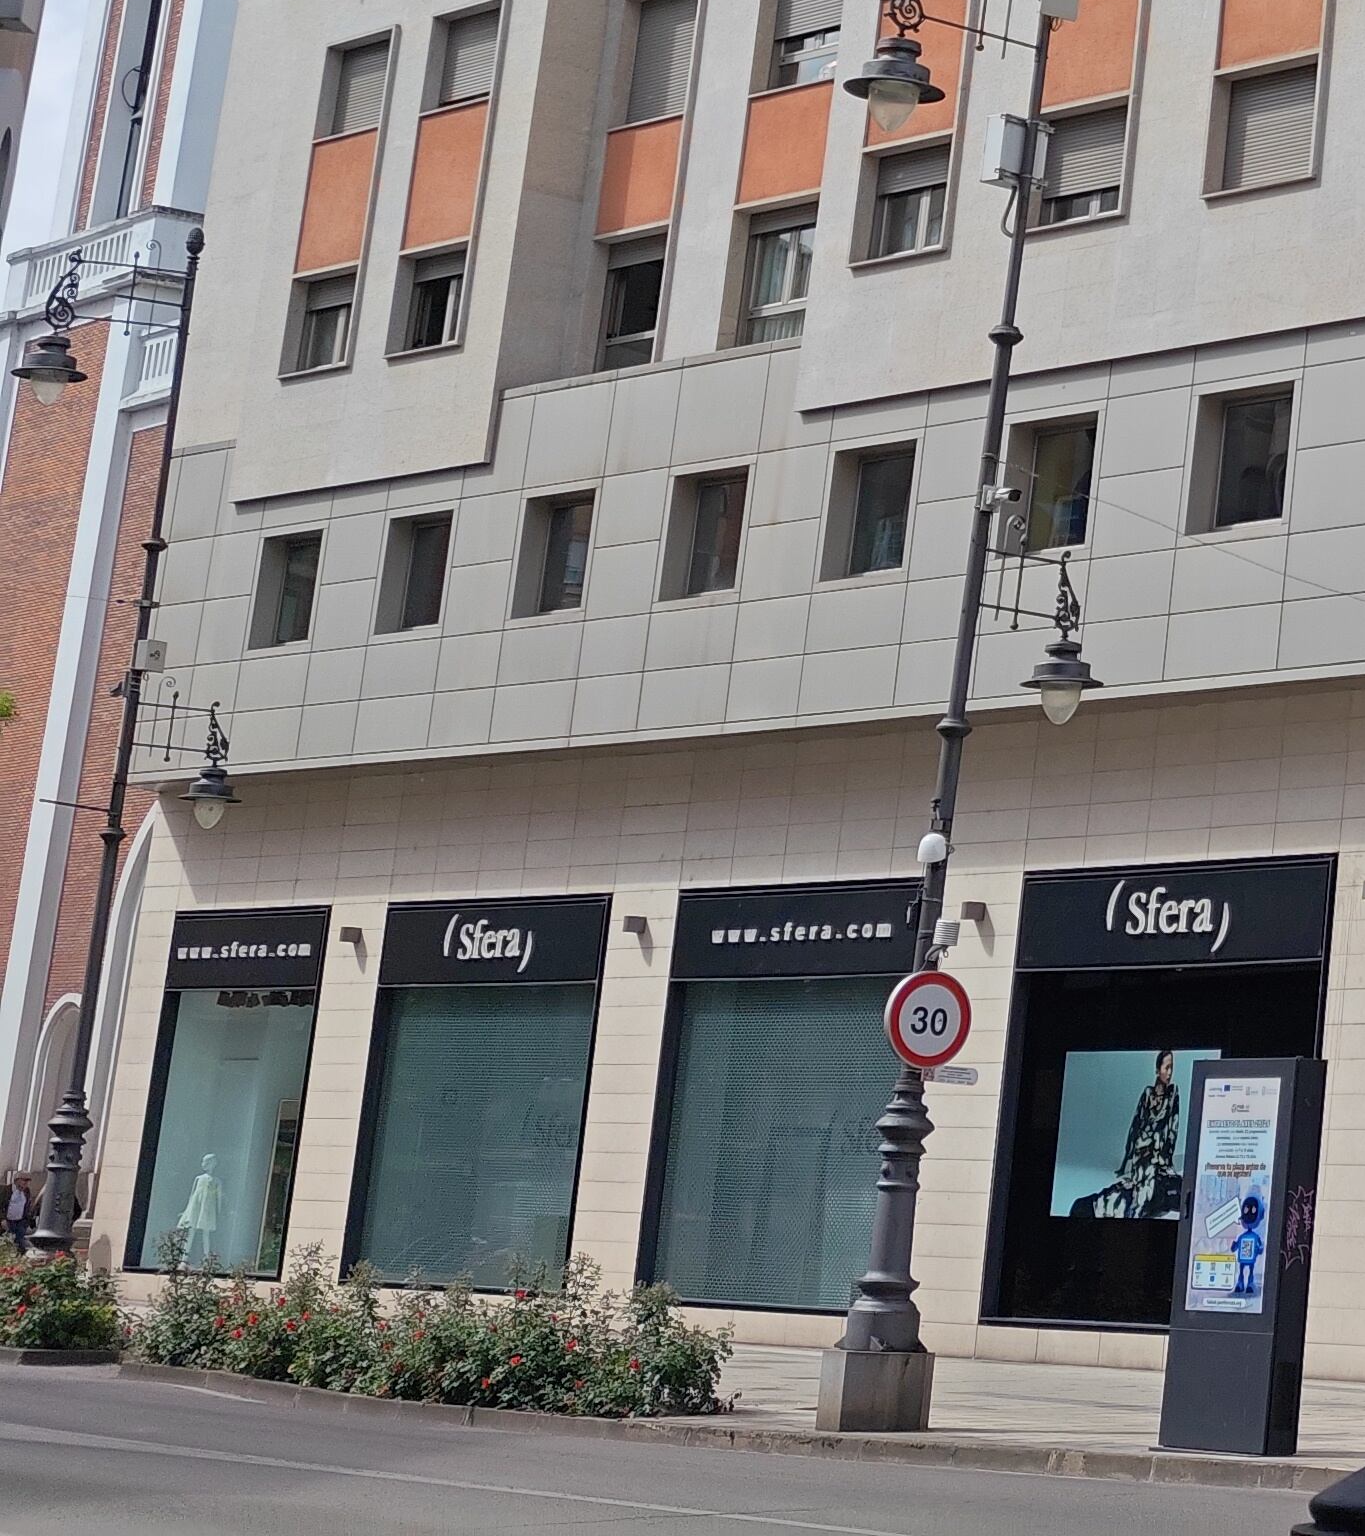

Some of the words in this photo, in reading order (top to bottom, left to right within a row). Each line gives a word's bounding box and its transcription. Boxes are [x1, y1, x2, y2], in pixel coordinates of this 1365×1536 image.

[711, 922, 892, 944] www.sfera.com
[177, 941, 312, 960] www.sfera.com
[910, 1006, 948, 1036] 30
